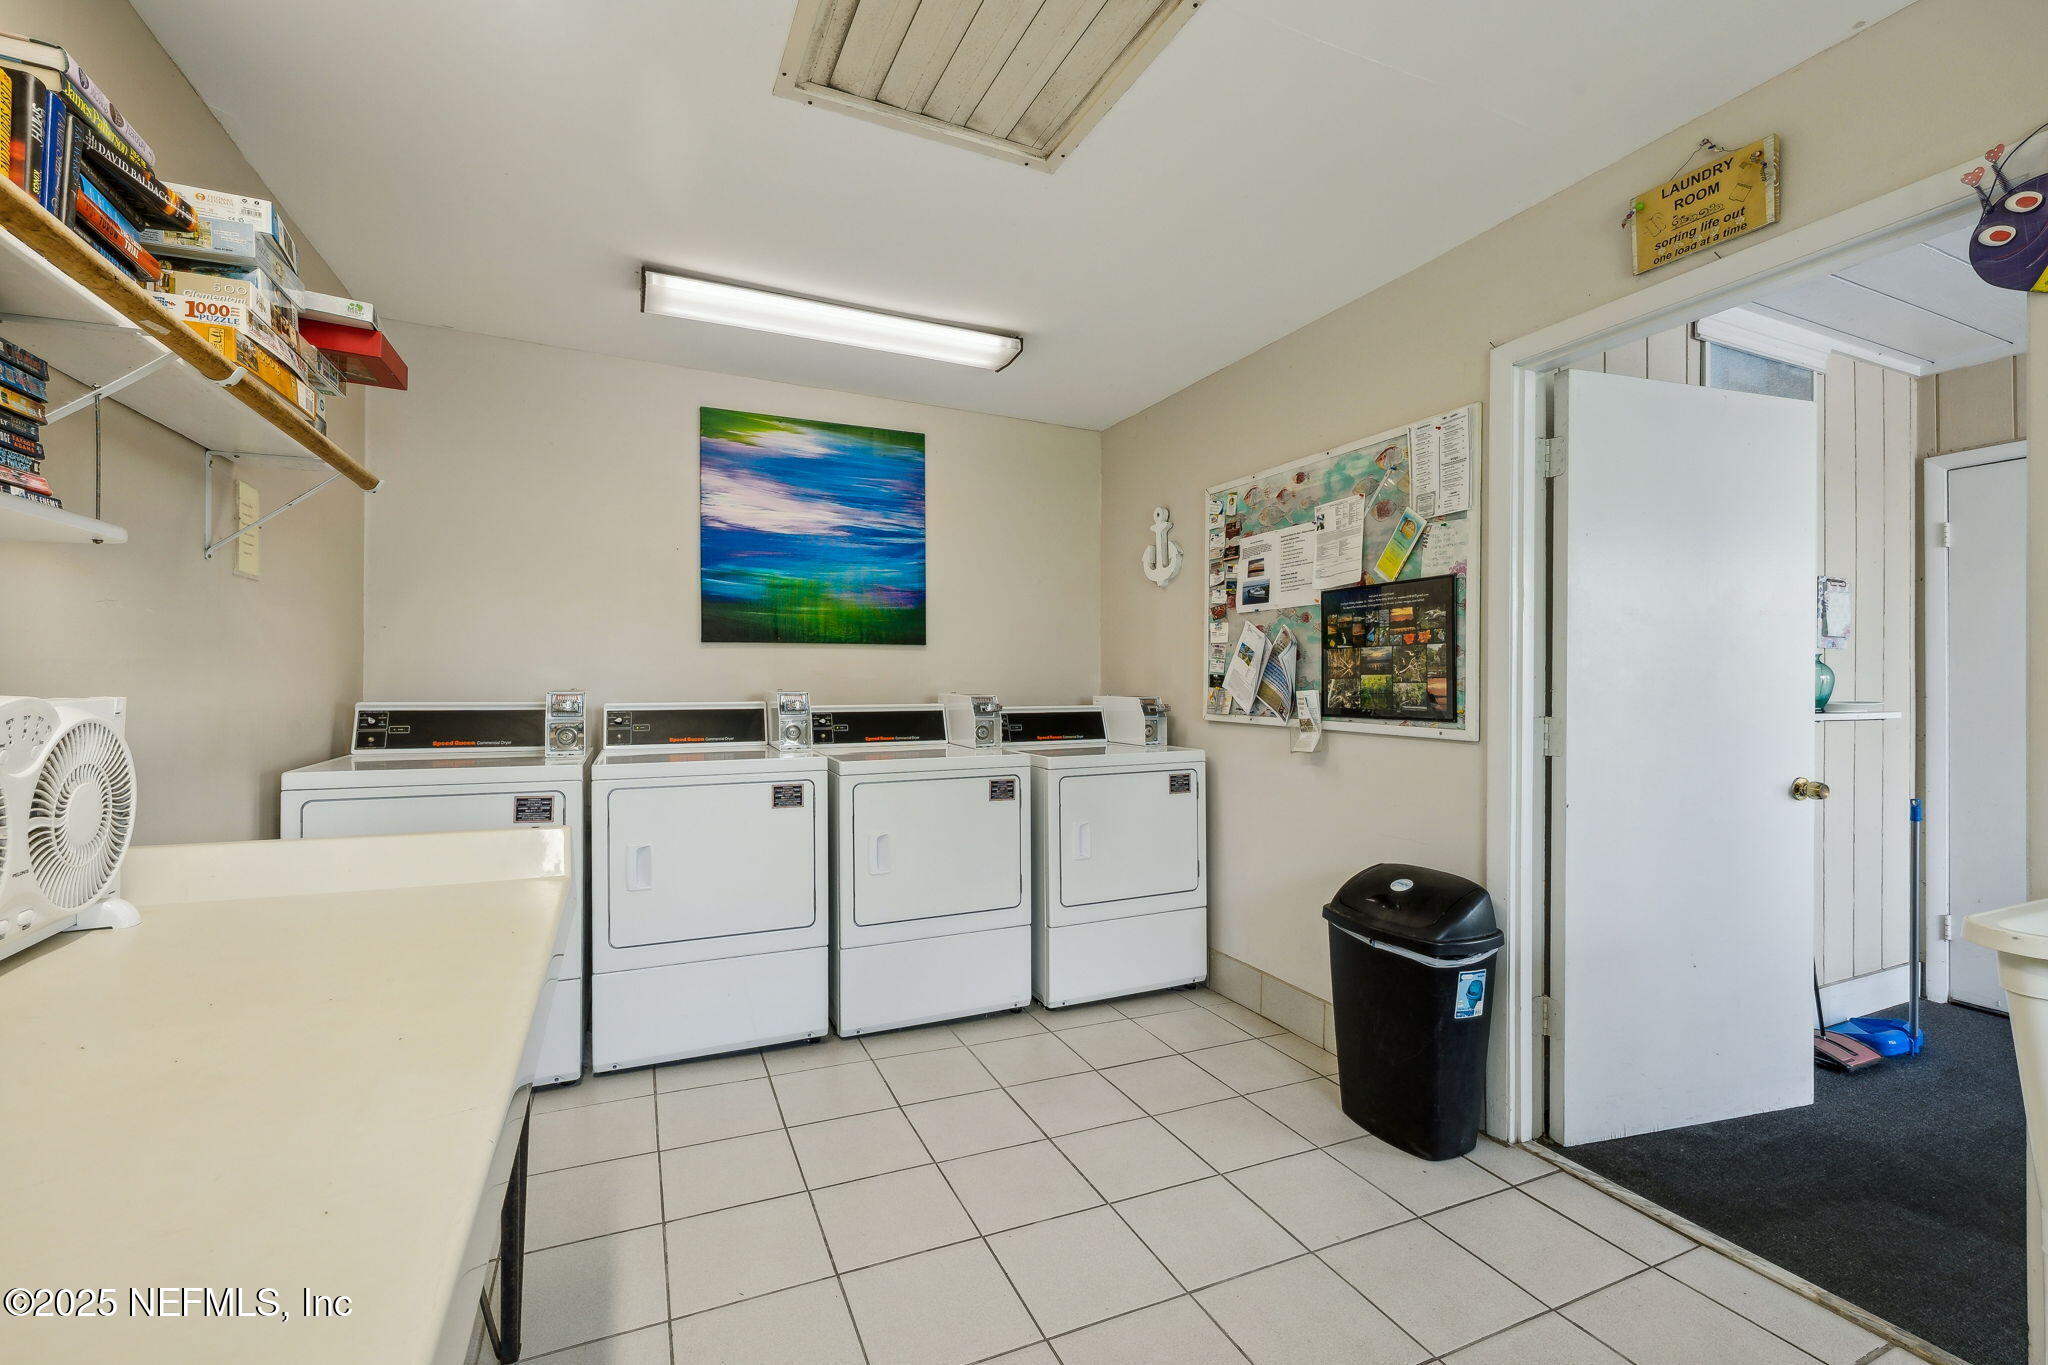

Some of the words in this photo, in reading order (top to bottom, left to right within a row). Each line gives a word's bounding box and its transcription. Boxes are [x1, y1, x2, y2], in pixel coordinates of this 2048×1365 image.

[31, 102, 43, 144] SMITH
[63, 80, 91, 118] James
[92, 107, 128, 156] Patterson
[98, 141, 130, 173] DAVID
[1661, 157, 1734, 199] LAUNDRY
[1674, 181, 1720, 211] ROOM
[1653, 252, 1672, 265] one
[1674, 242, 1697, 257] load
[1699, 236, 1711, 247] at
[1712, 233, 1720, 242] a
[1723, 222, 1748, 238] time
[1654, 227, 1697, 251] sorting
[1700, 217, 1720, 232] life
[1723, 206, 1746, 223] out
[124, 240, 140, 260] TRIAL
[213, 282, 248, 295] 500
[184, 300, 230, 318] 1000
[198, 314, 240, 325] PUZZLE
[27, 493, 39, 502] THE
[39, 496, 59, 508] ENEMY
